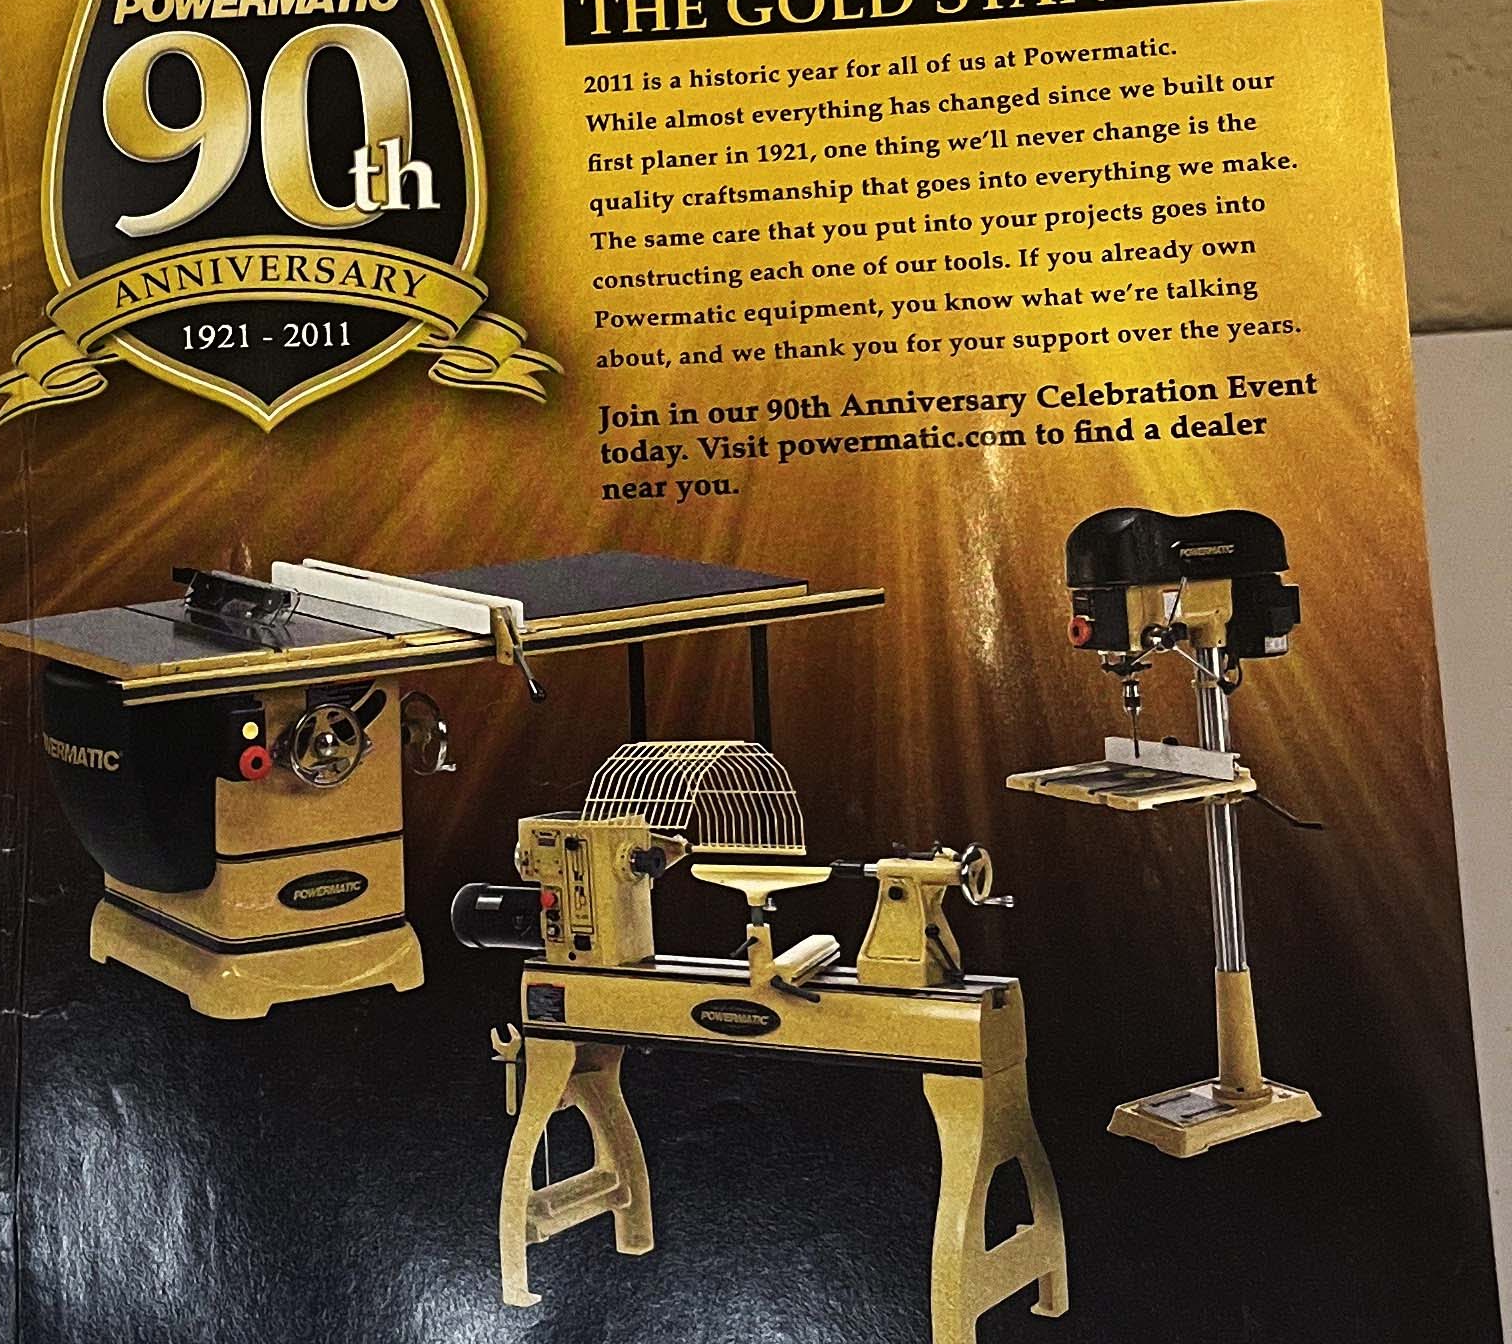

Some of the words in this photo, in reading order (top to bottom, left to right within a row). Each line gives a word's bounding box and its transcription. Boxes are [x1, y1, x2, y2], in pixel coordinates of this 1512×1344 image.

[589, 190, 675, 218] quality
[682, 179, 854, 207] craftsmanship
[862, 176, 909, 196] that
[916, 176, 971, 200] goes
[978, 170, 1027, 190] into
[1035, 160, 1171, 189] everything
[1177, 160, 1214, 176] we
[1221, 151, 1298, 174] make.
[114, 255, 428, 309] ANNIVERSARY
[183, 323, 249, 350] 1921
[283, 321, 351, 348] 2011
[597, 403, 661, 435] Join
[668, 402, 700, 426] in
[708, 405, 759, 424] our
[766, 394, 833, 422] 90th
[839, 390, 1027, 418] Anniversary
[1036, 378, 1219, 409] Celebration
[1226, 372, 1318, 399] Event
[600, 438, 689, 469] today.
[696, 434, 769, 460] Visit
[776, 425, 1027, 467] powermatic.com
[1035, 423, 1065, 446] to
[1073, 417, 1135, 444] find
[1144, 423, 1161, 440] a
[1170, 411, 1268, 439] dealer
[601, 480, 668, 501] near
[674, 478, 740, 505] you.
